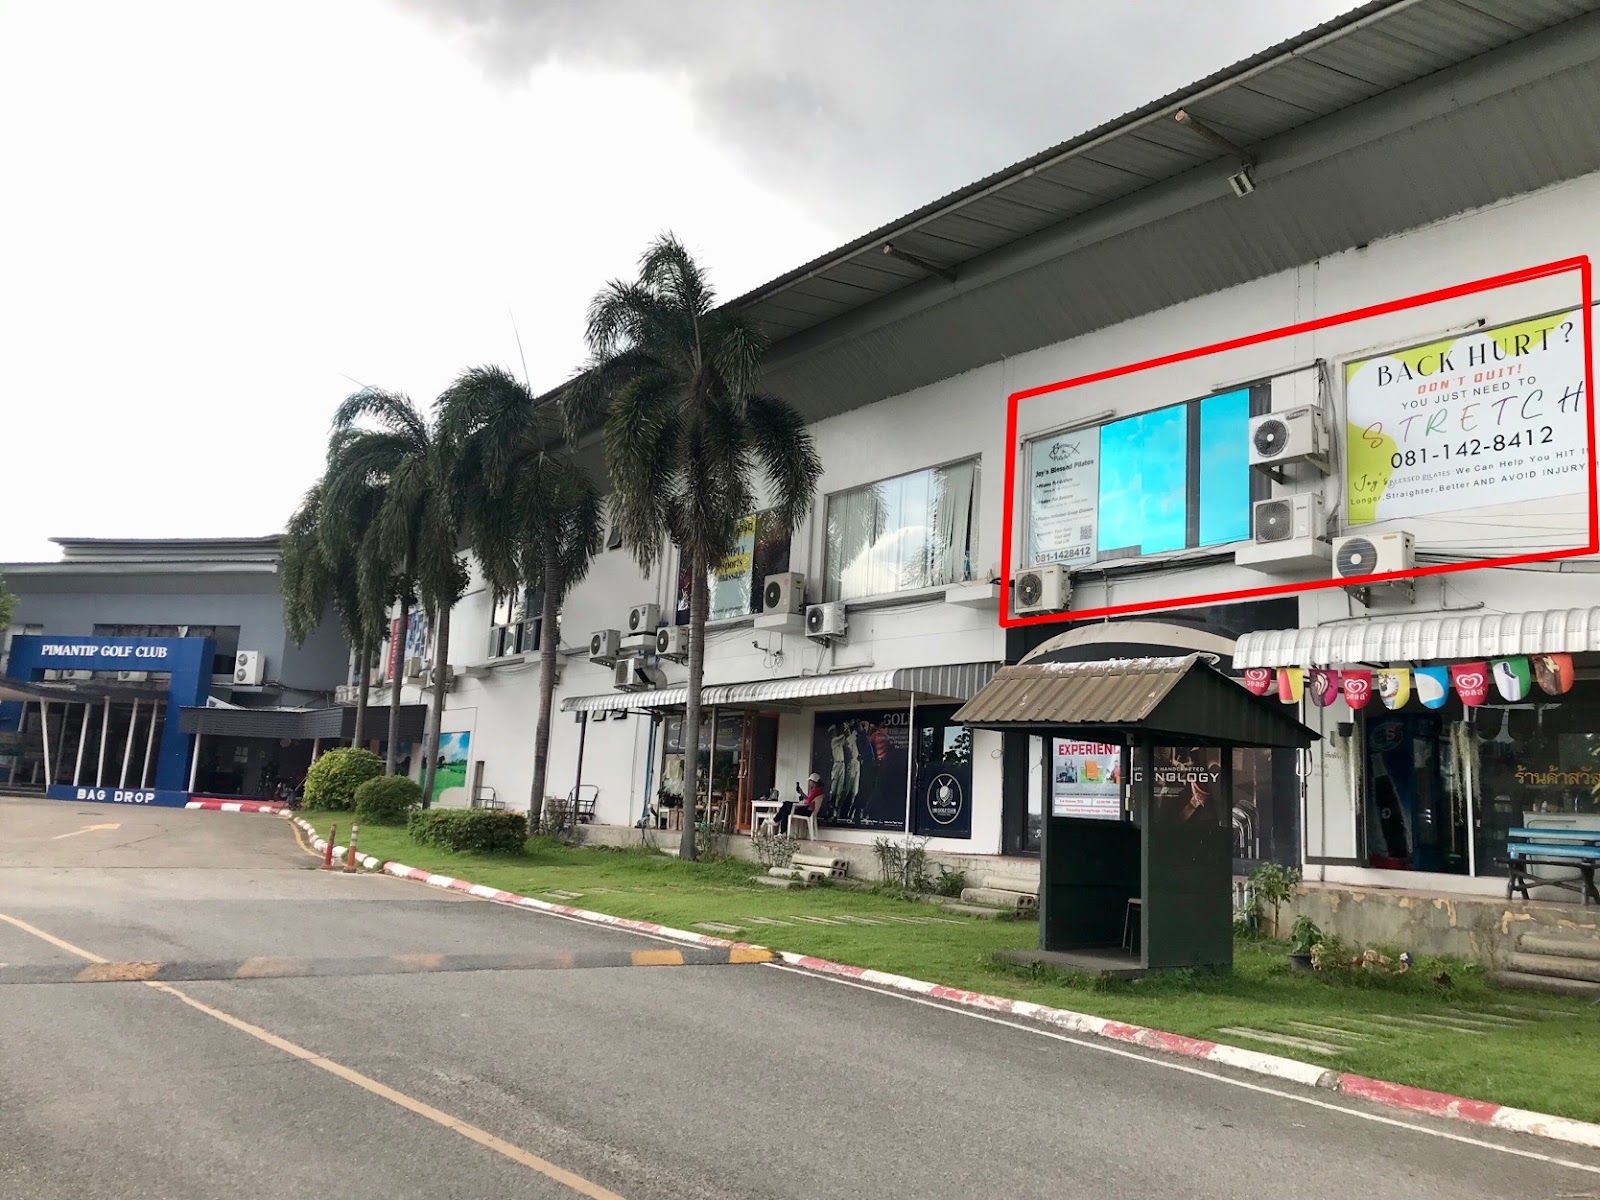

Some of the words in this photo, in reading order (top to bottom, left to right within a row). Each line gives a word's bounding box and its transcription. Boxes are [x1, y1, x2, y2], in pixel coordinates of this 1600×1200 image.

[1377, 350, 1454, 387] BACK
[1417, 375, 1467, 394] DON'T
[1473, 363, 1523, 383] QUIT!
[1401, 398, 1428, 411] YOU
[1434, 389, 1468, 405] JUST
[1473, 381, 1510, 396] NEED
[1519, 375, 1537, 387] TO
[1391, 426, 1553, 469] 081-142-8412
[1050, 463, 1073, 474] Blessed
[1073, 459, 1094, 469] Pilates
[1455, 467, 1471, 475] We
[1474, 463, 1494, 472] Can
[1500, 458, 1524, 468] Help
[1530, 455, 1550, 463] You
[1556, 449, 1575, 458] HIT
[1473, 477, 1495, 487] AND
[1501, 471, 1537, 483] AVOID
[1036, 546, 1091, 563] 081-1428412
[41, 644, 98, 656] PIMANTIP
[100, 645, 133, 657] GOLF
[135, 646, 168, 658] CLUB
[77, 788, 106, 801] BAG
[113, 790, 155, 804] DROP
